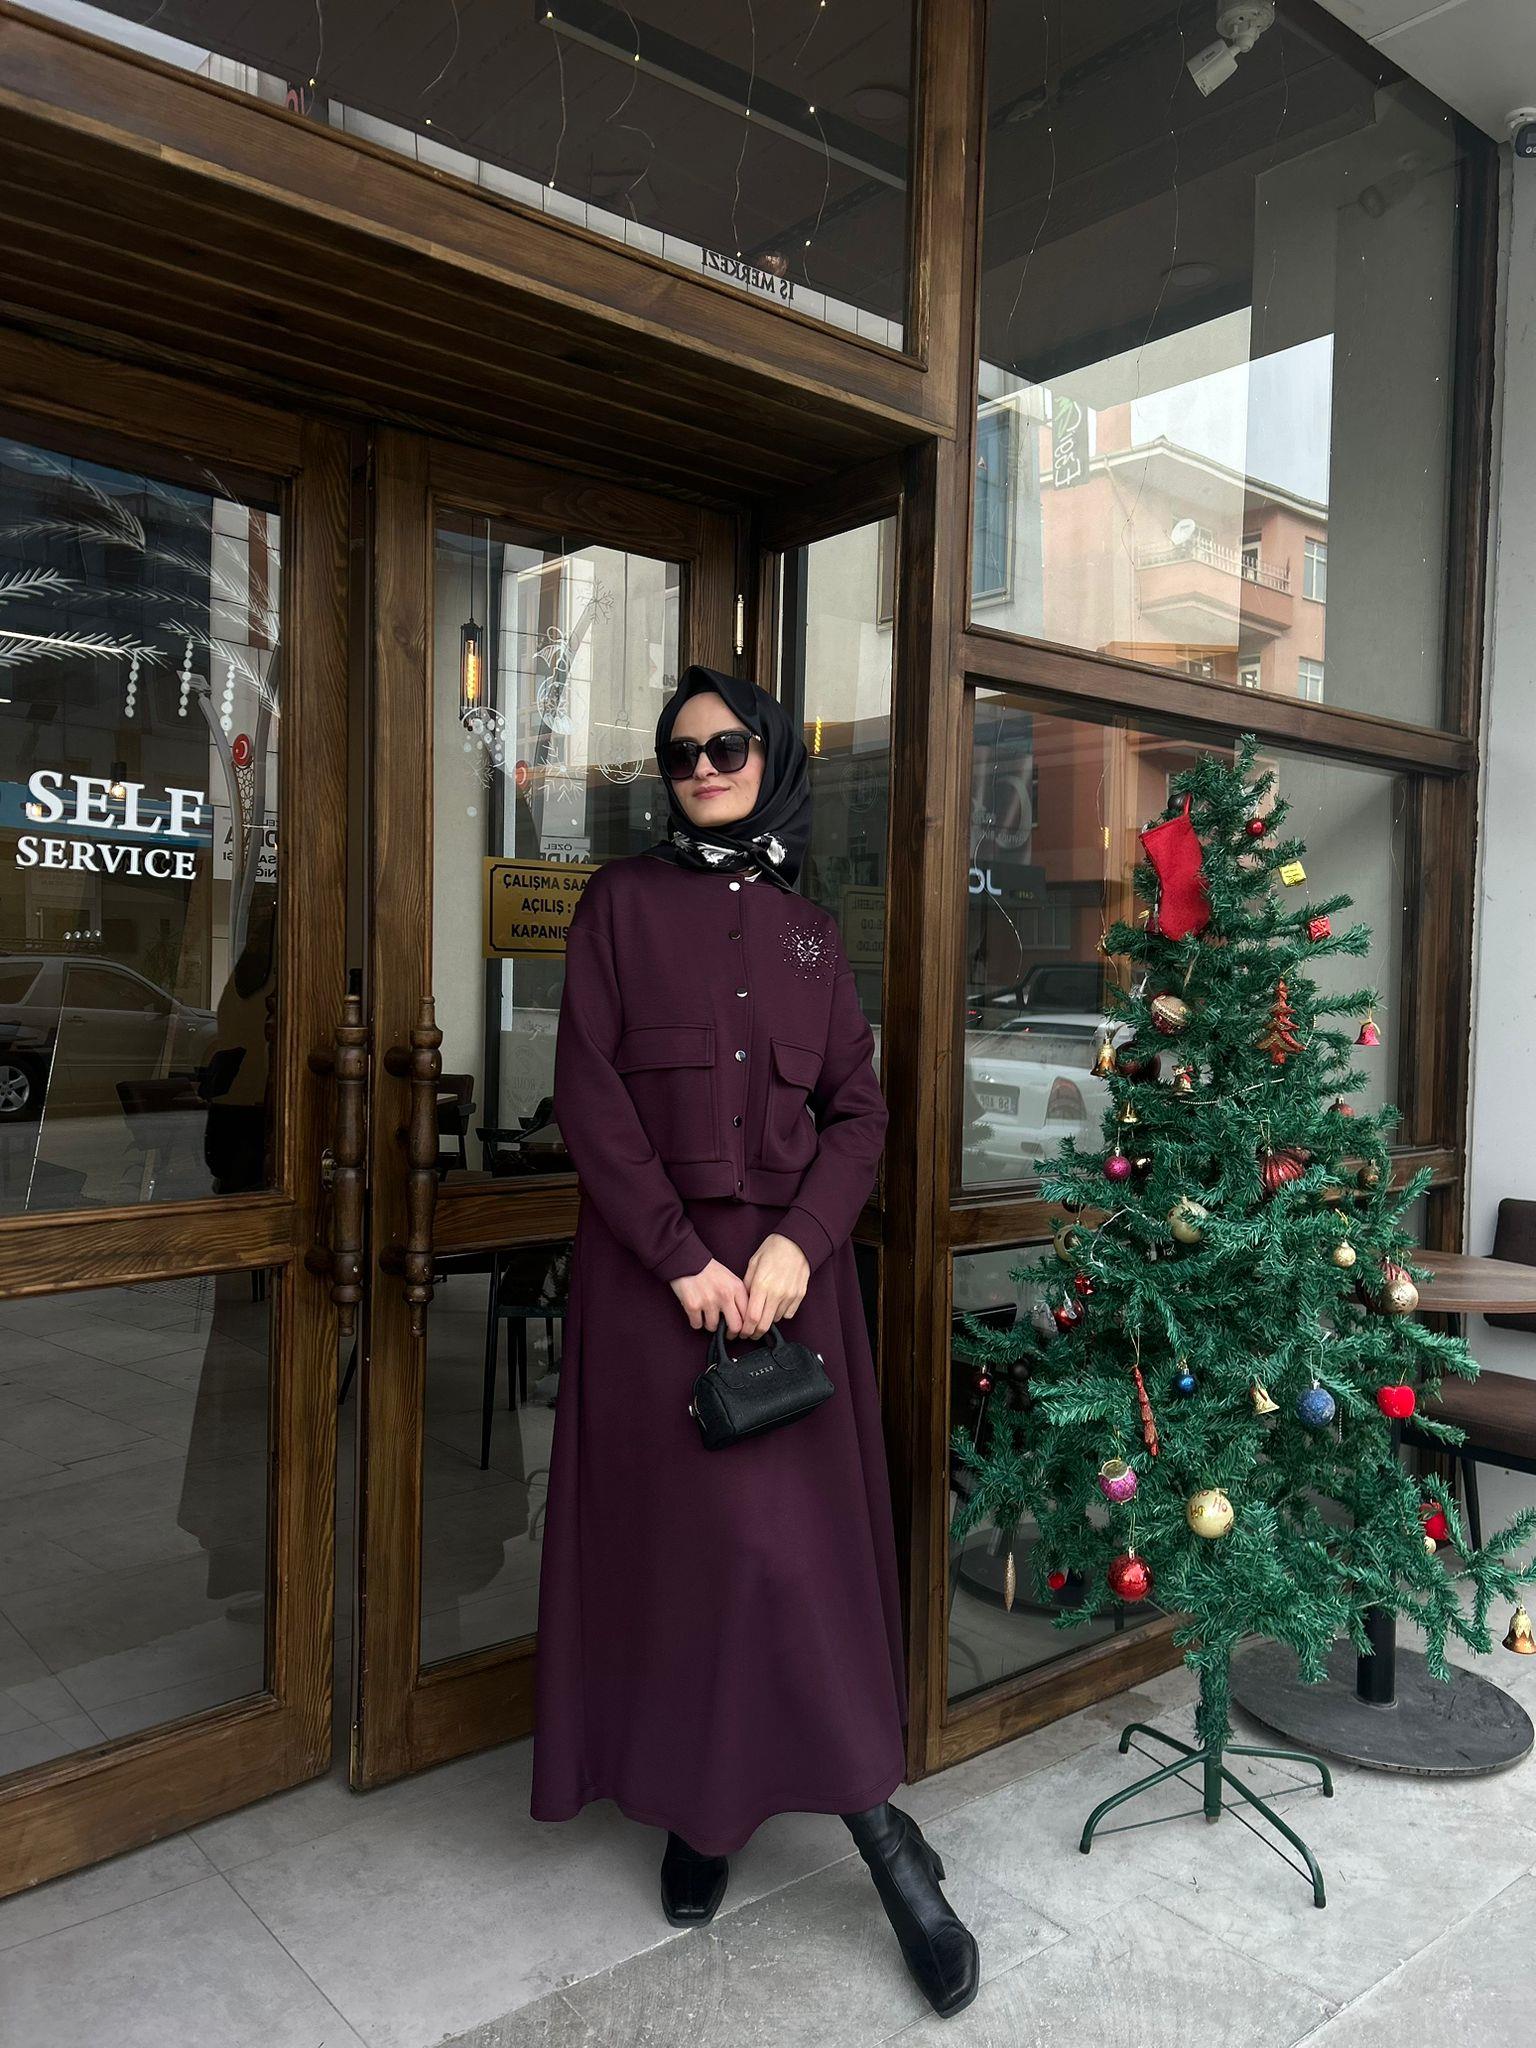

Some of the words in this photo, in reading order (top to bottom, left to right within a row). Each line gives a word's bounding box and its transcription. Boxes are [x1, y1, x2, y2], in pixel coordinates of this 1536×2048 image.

[26, 769, 206, 837] SELF
[15, 835, 197, 881] SERVICE
[503, 873, 560, 891] ÇALIŞMA
[521, 898, 564, 915] AÇILIŞ
[511, 924, 568, 941] KAPANIŞ
